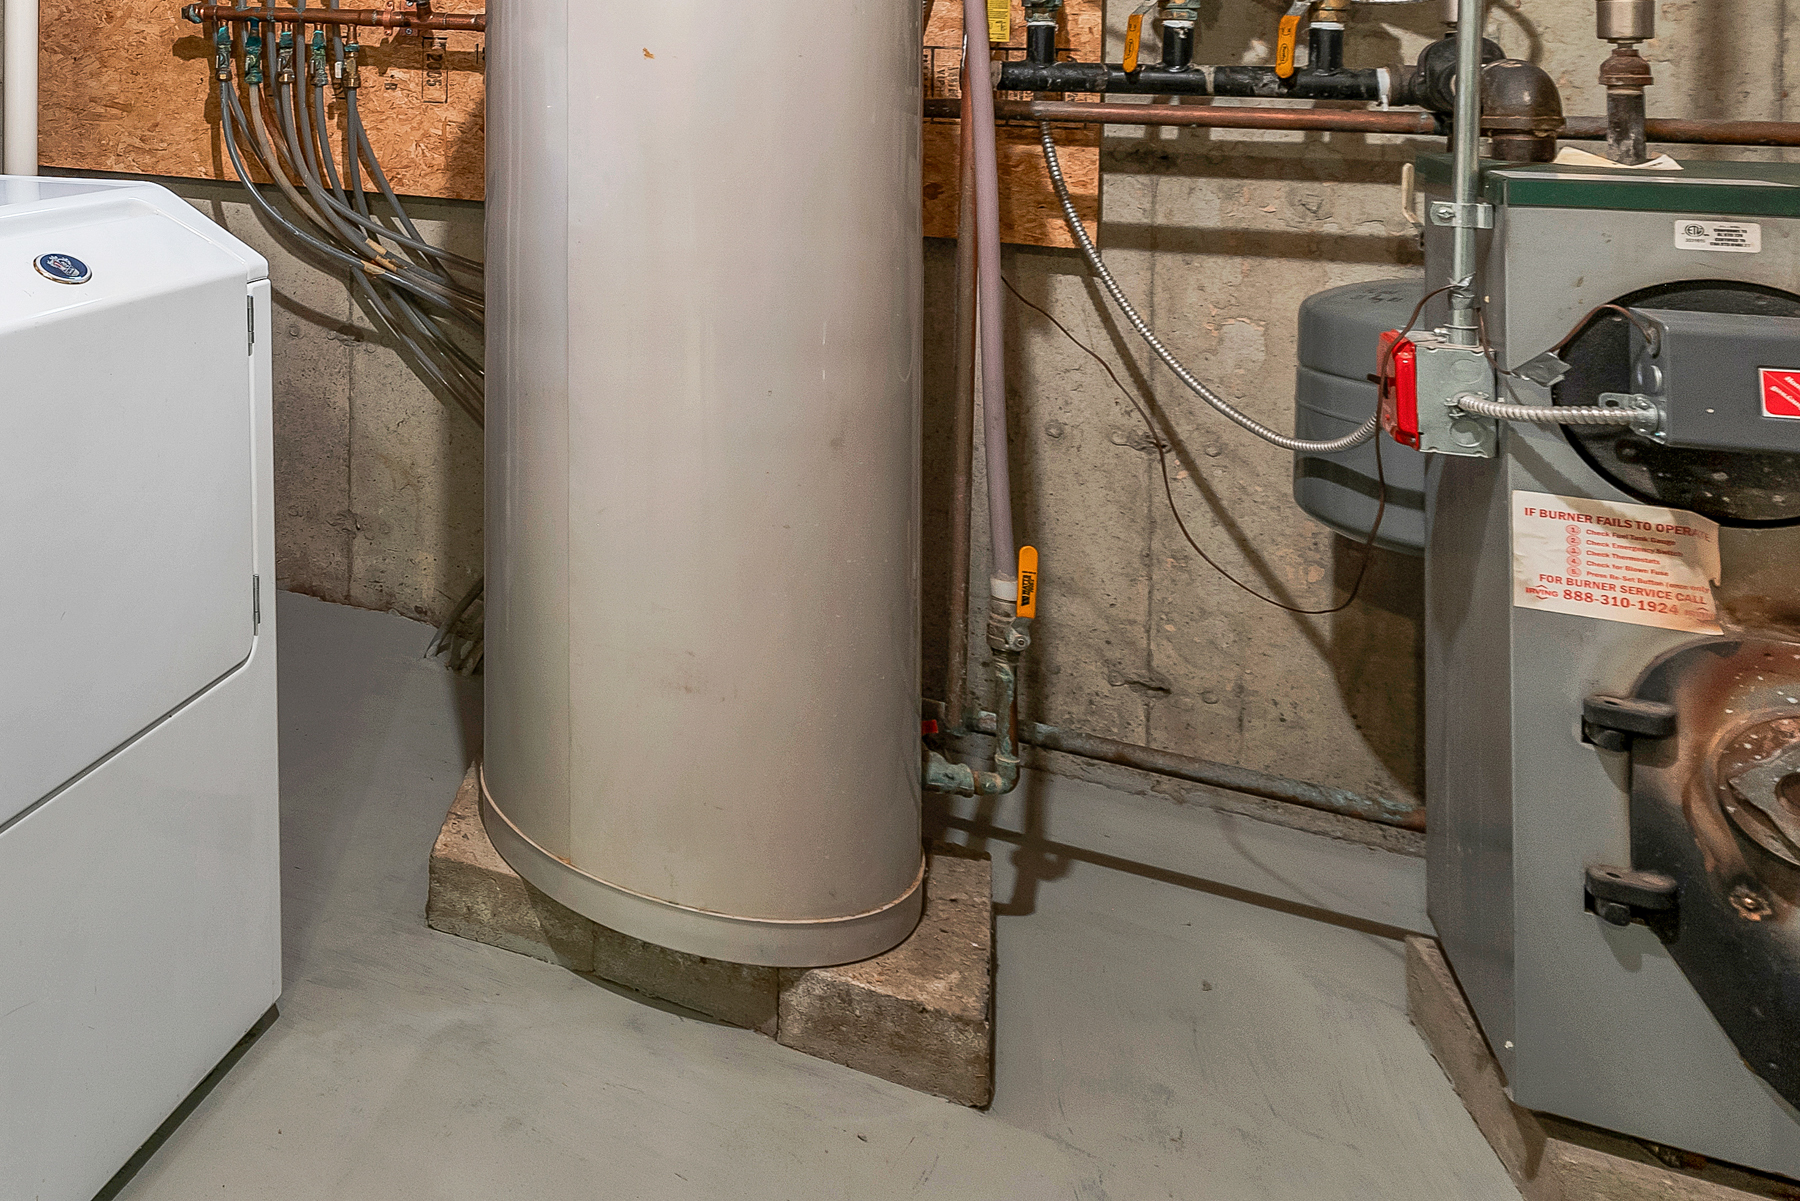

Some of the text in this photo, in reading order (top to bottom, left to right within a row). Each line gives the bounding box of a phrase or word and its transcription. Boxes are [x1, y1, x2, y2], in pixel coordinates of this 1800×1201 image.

[1524, 507, 1536, 517] IF
[1539, 508, 1593, 524] BURNER
[1596, 515, 1633, 529] FAILS
[1636, 521, 1652, 531] TO
[1586, 529, 1610, 537] Check
[1650, 537, 1676, 546] Gauge
[1586, 539, 1610, 548] Check
[1612, 543, 1654, 554] Emergency
[1656, 549, 1684, 557] Switch
[1586, 550, 1610, 558] Check
[1586, 560, 1610, 569] Check
[1612, 563, 1623, 571] for
[1624, 565, 1649, 574] Blown
[1650, 569, 1669, 577] Fuse
[1586, 570, 1608, 579] Press
[1609, 574, 1635, 583] Re-Set
[1637, 578, 1664, 587] Button
[1539, 573, 1707, 605] FOR BURNER SERVICE CALL
[1525, 586, 1559, 598] IRVING
[1563, 589, 1680, 616] 888-310-1924
